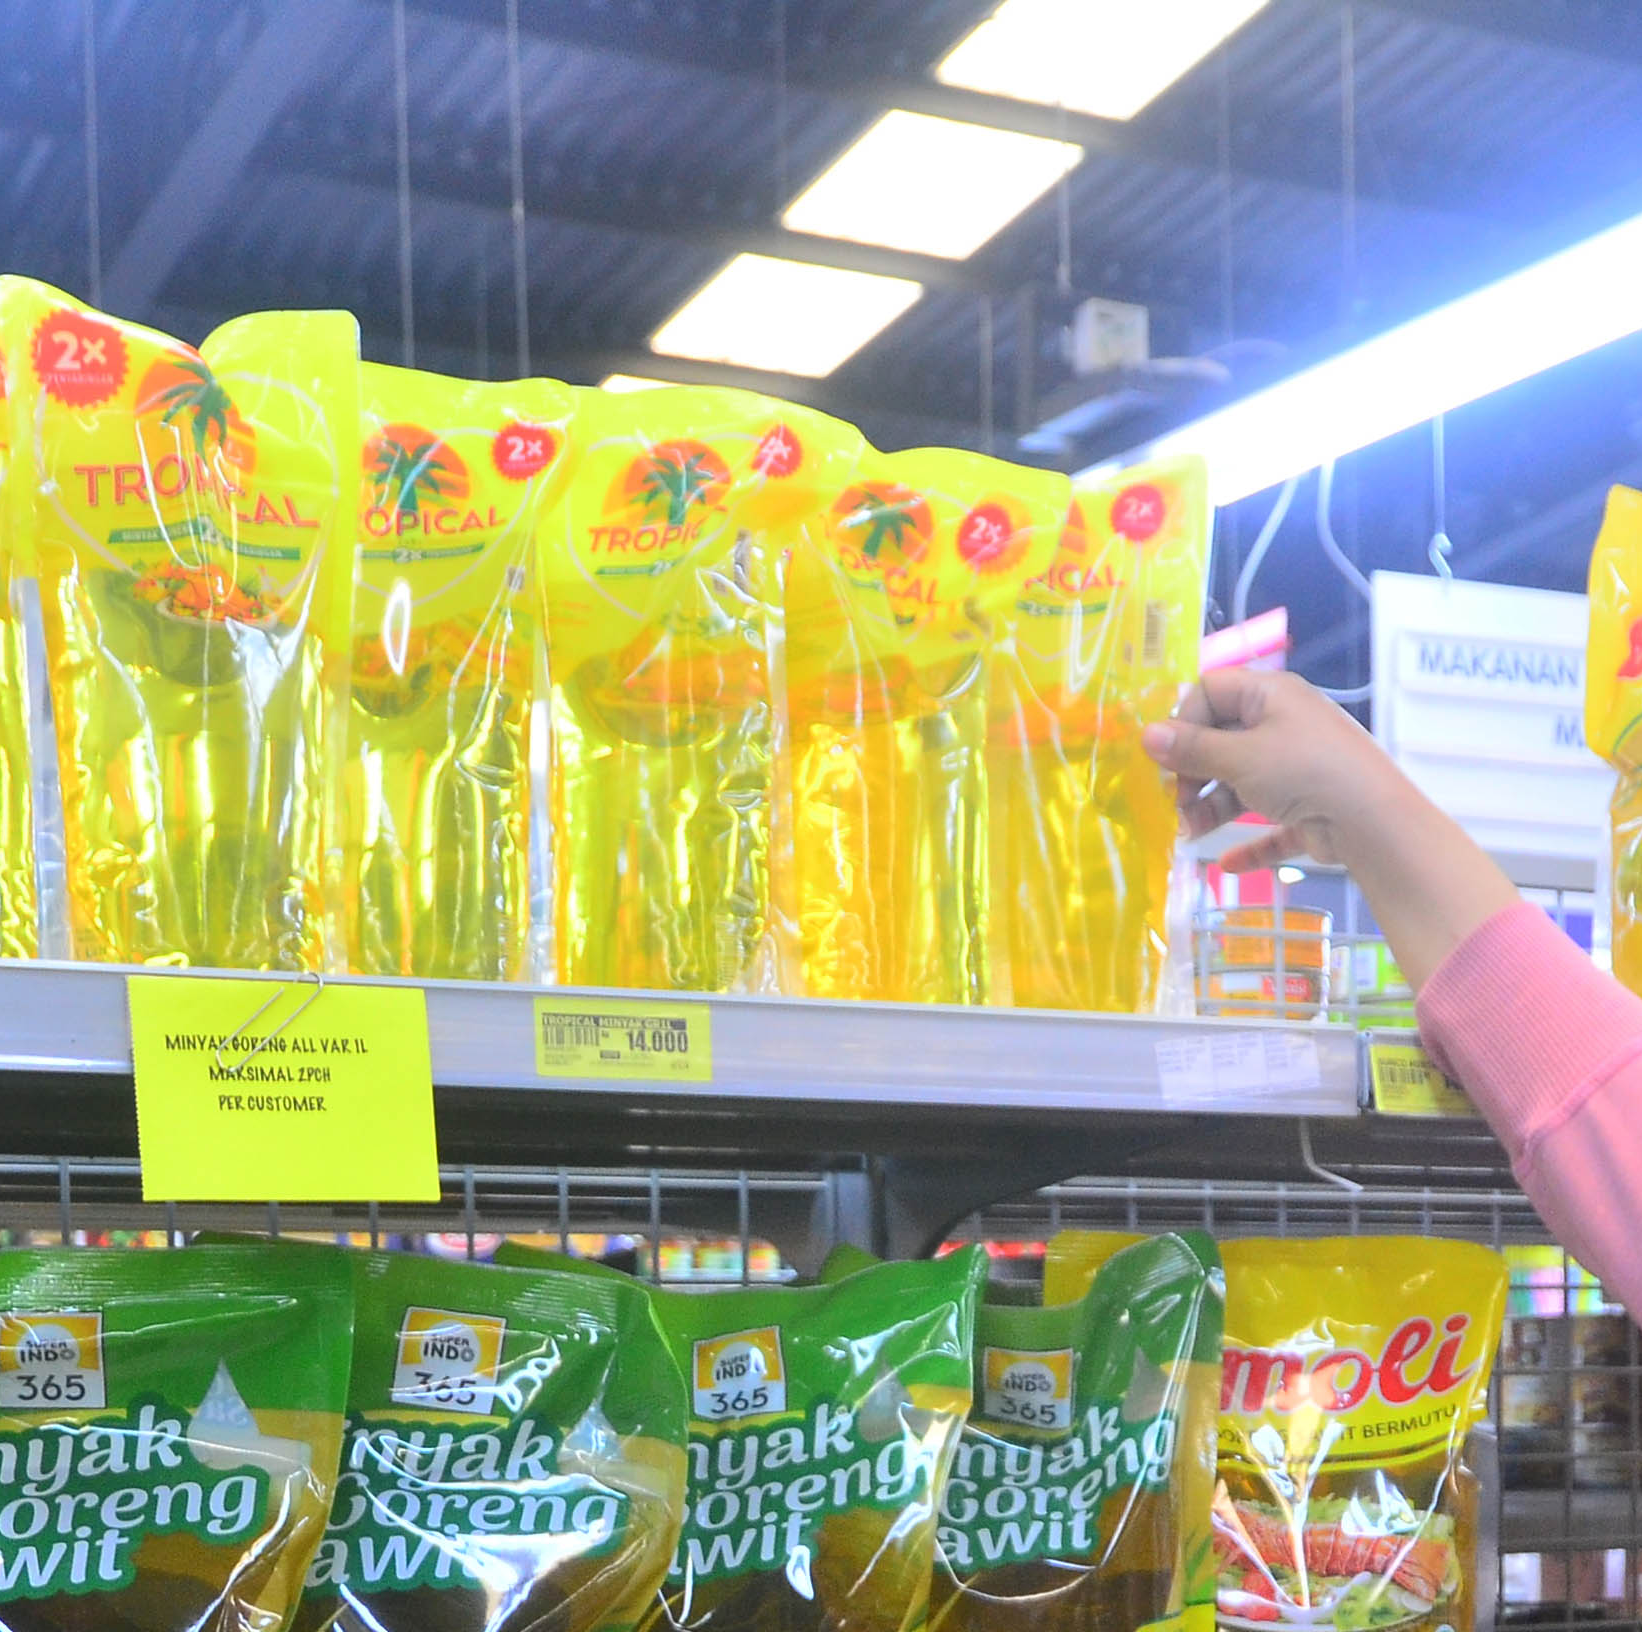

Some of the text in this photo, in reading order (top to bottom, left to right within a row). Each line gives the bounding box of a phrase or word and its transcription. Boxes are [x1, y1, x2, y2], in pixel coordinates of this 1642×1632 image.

[1417, 640, 1581, 689] MAKANAN
[164, 1034, 232, 1051] MINYAK
[232, 1035, 287, 1052] GORENG
[291, 1038, 318, 1053] ALL
[321, 1038, 352, 1054] VAR
[627, 1030, 689, 1053] 14.000
[208, 1065, 295, 1082] MAKSIMAL
[218, 1095, 327, 1112] PER CUSTOMER
[19, 1348, 75, 1364] INDO
[422, 1341, 476, 1363] INDO
[1220, 1313, 1478, 1413] moli
[16, 1375, 86, 1402] 365
[412, 1371, 477, 1406] 365
[710, 1387, 769, 1414] 365
[999, 1396, 1057, 1426] 365
[1362, 1404, 1457, 1439] BERMUTU
[682, 1440, 914, 1530] oreng
[938, 1418, 1176, 1525] Goreng
[935, 1510, 1095, 1565] awit
